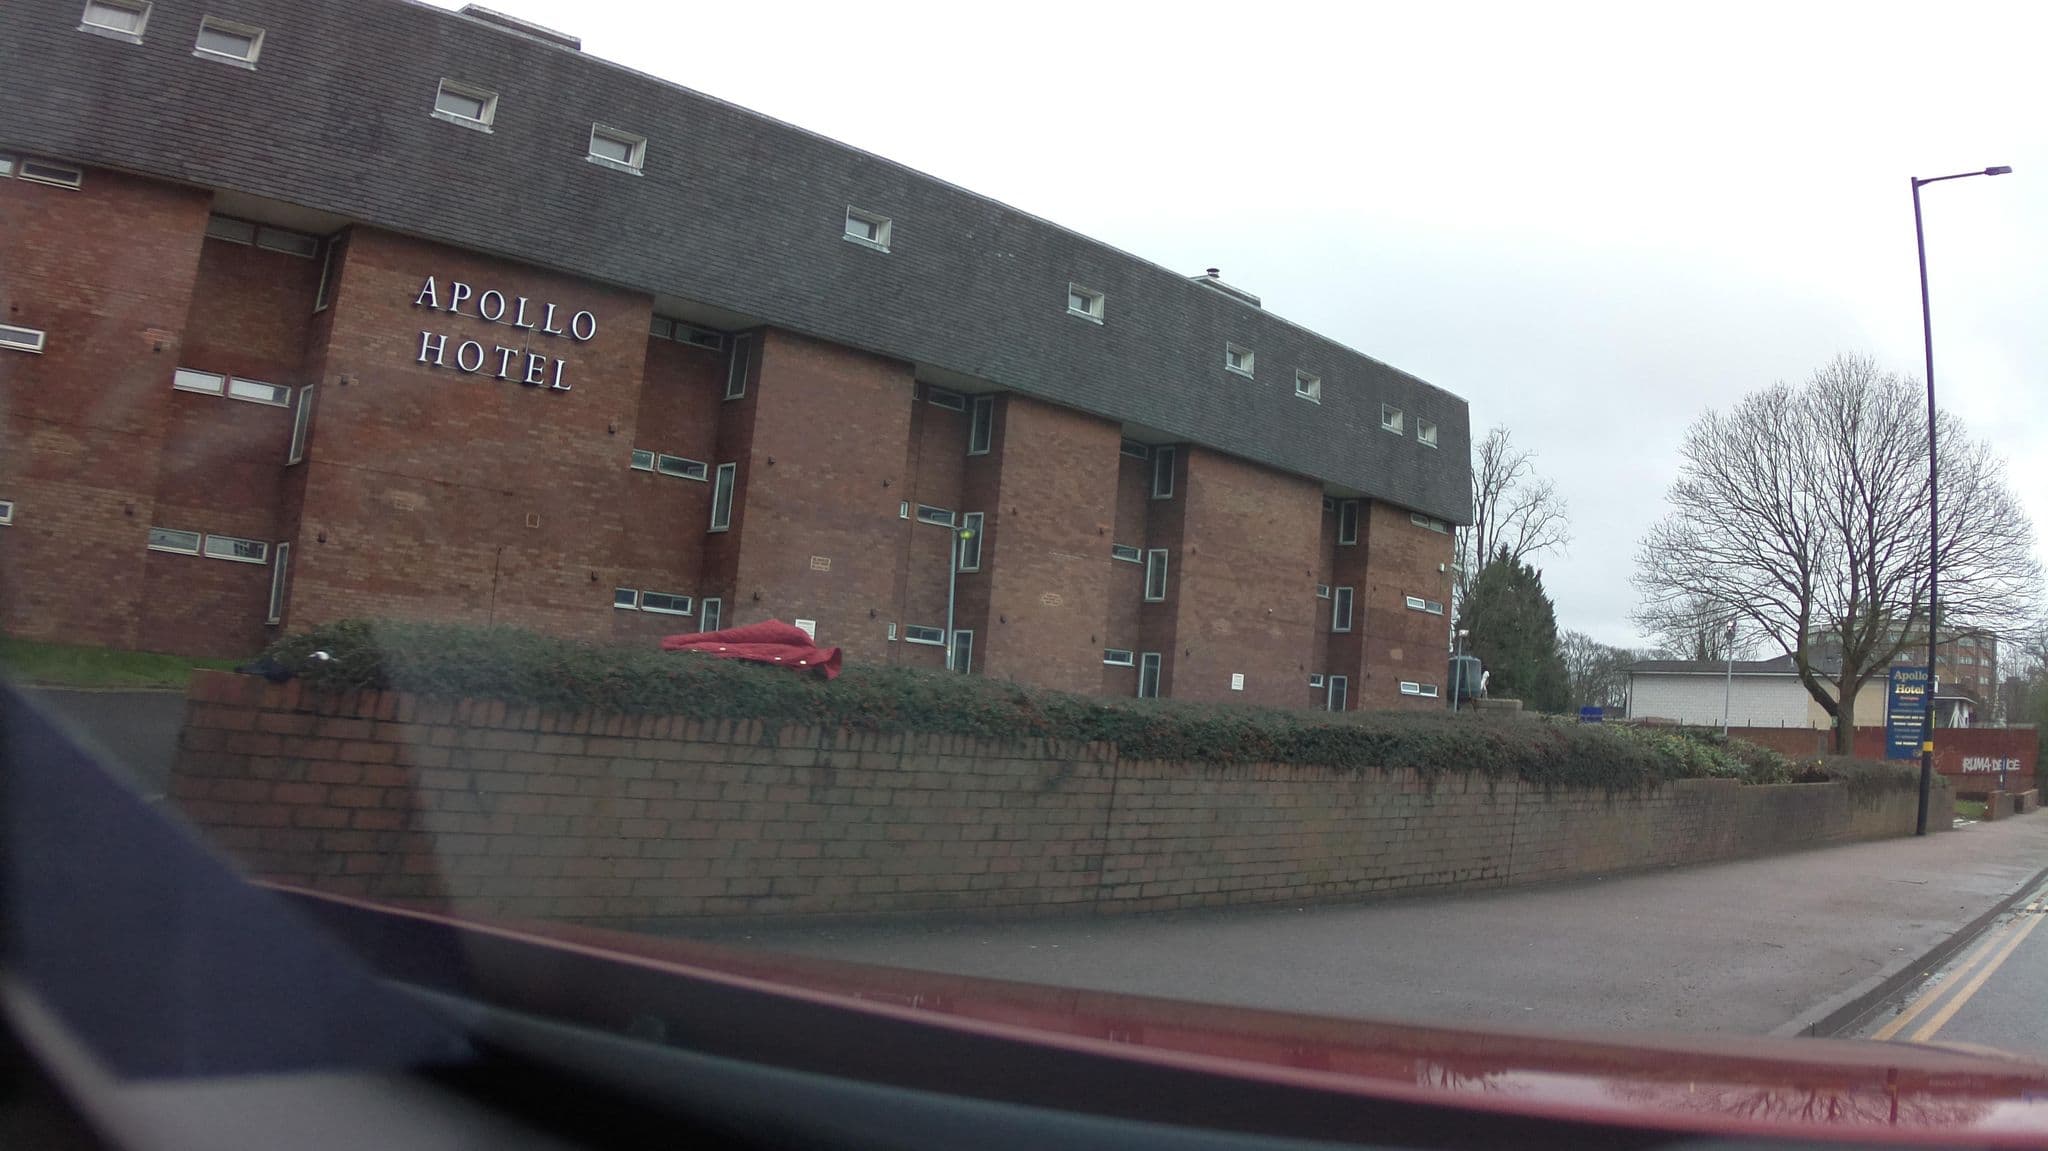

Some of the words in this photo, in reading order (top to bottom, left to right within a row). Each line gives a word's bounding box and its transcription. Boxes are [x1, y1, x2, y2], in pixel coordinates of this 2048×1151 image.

[415, 275, 597, 341] APOLLO
[417, 331, 572, 391] HOTEL
[1894, 670, 1928, 682] Apollo
[1895, 684, 1925, 694] Hotel
